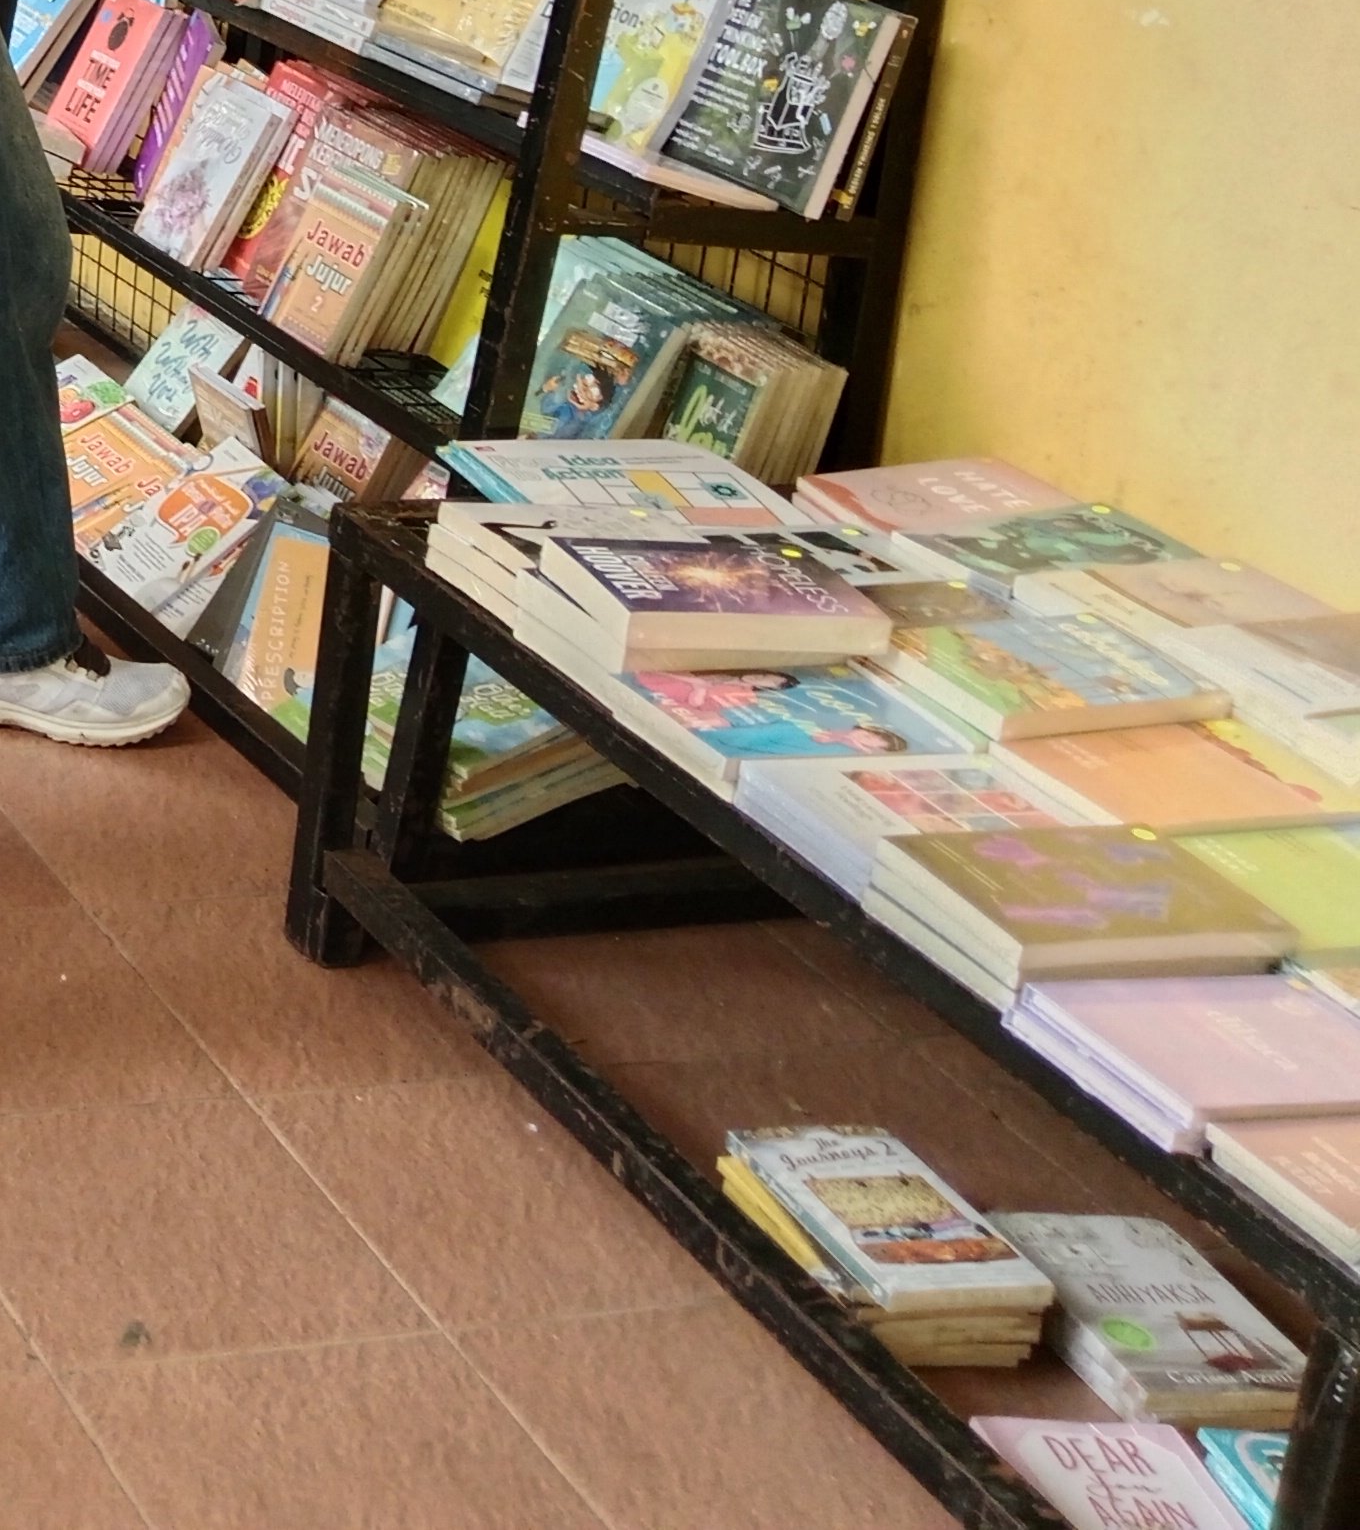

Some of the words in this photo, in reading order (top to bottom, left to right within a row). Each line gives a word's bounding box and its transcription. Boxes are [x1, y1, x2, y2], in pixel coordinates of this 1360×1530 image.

[82, 58, 117, 90] TIME
[65, 87, 102, 124] LIFE
[306, 220, 371, 269] Jawab
[306, 254, 353, 295] Jujur
[311, 295, 323, 313] 2
[79, 432, 134, 475] Jawab
[312, 430, 370, 483] Jawab
[917, 475, 994, 515] LOVE
[956, 469, 1032, 509] HATE
[576, 544, 665, 601] HOOVER
[260, 560, 291, 702] PRESCRIPTION
[778, 1144, 877, 1171] Journeys
[878, 1140, 901, 1157] 2
[814, 1135, 841, 1152] The
[1043, 1434, 1159, 1477] DEAR
[1094, 1499, 1194, 1530] AGAIN
